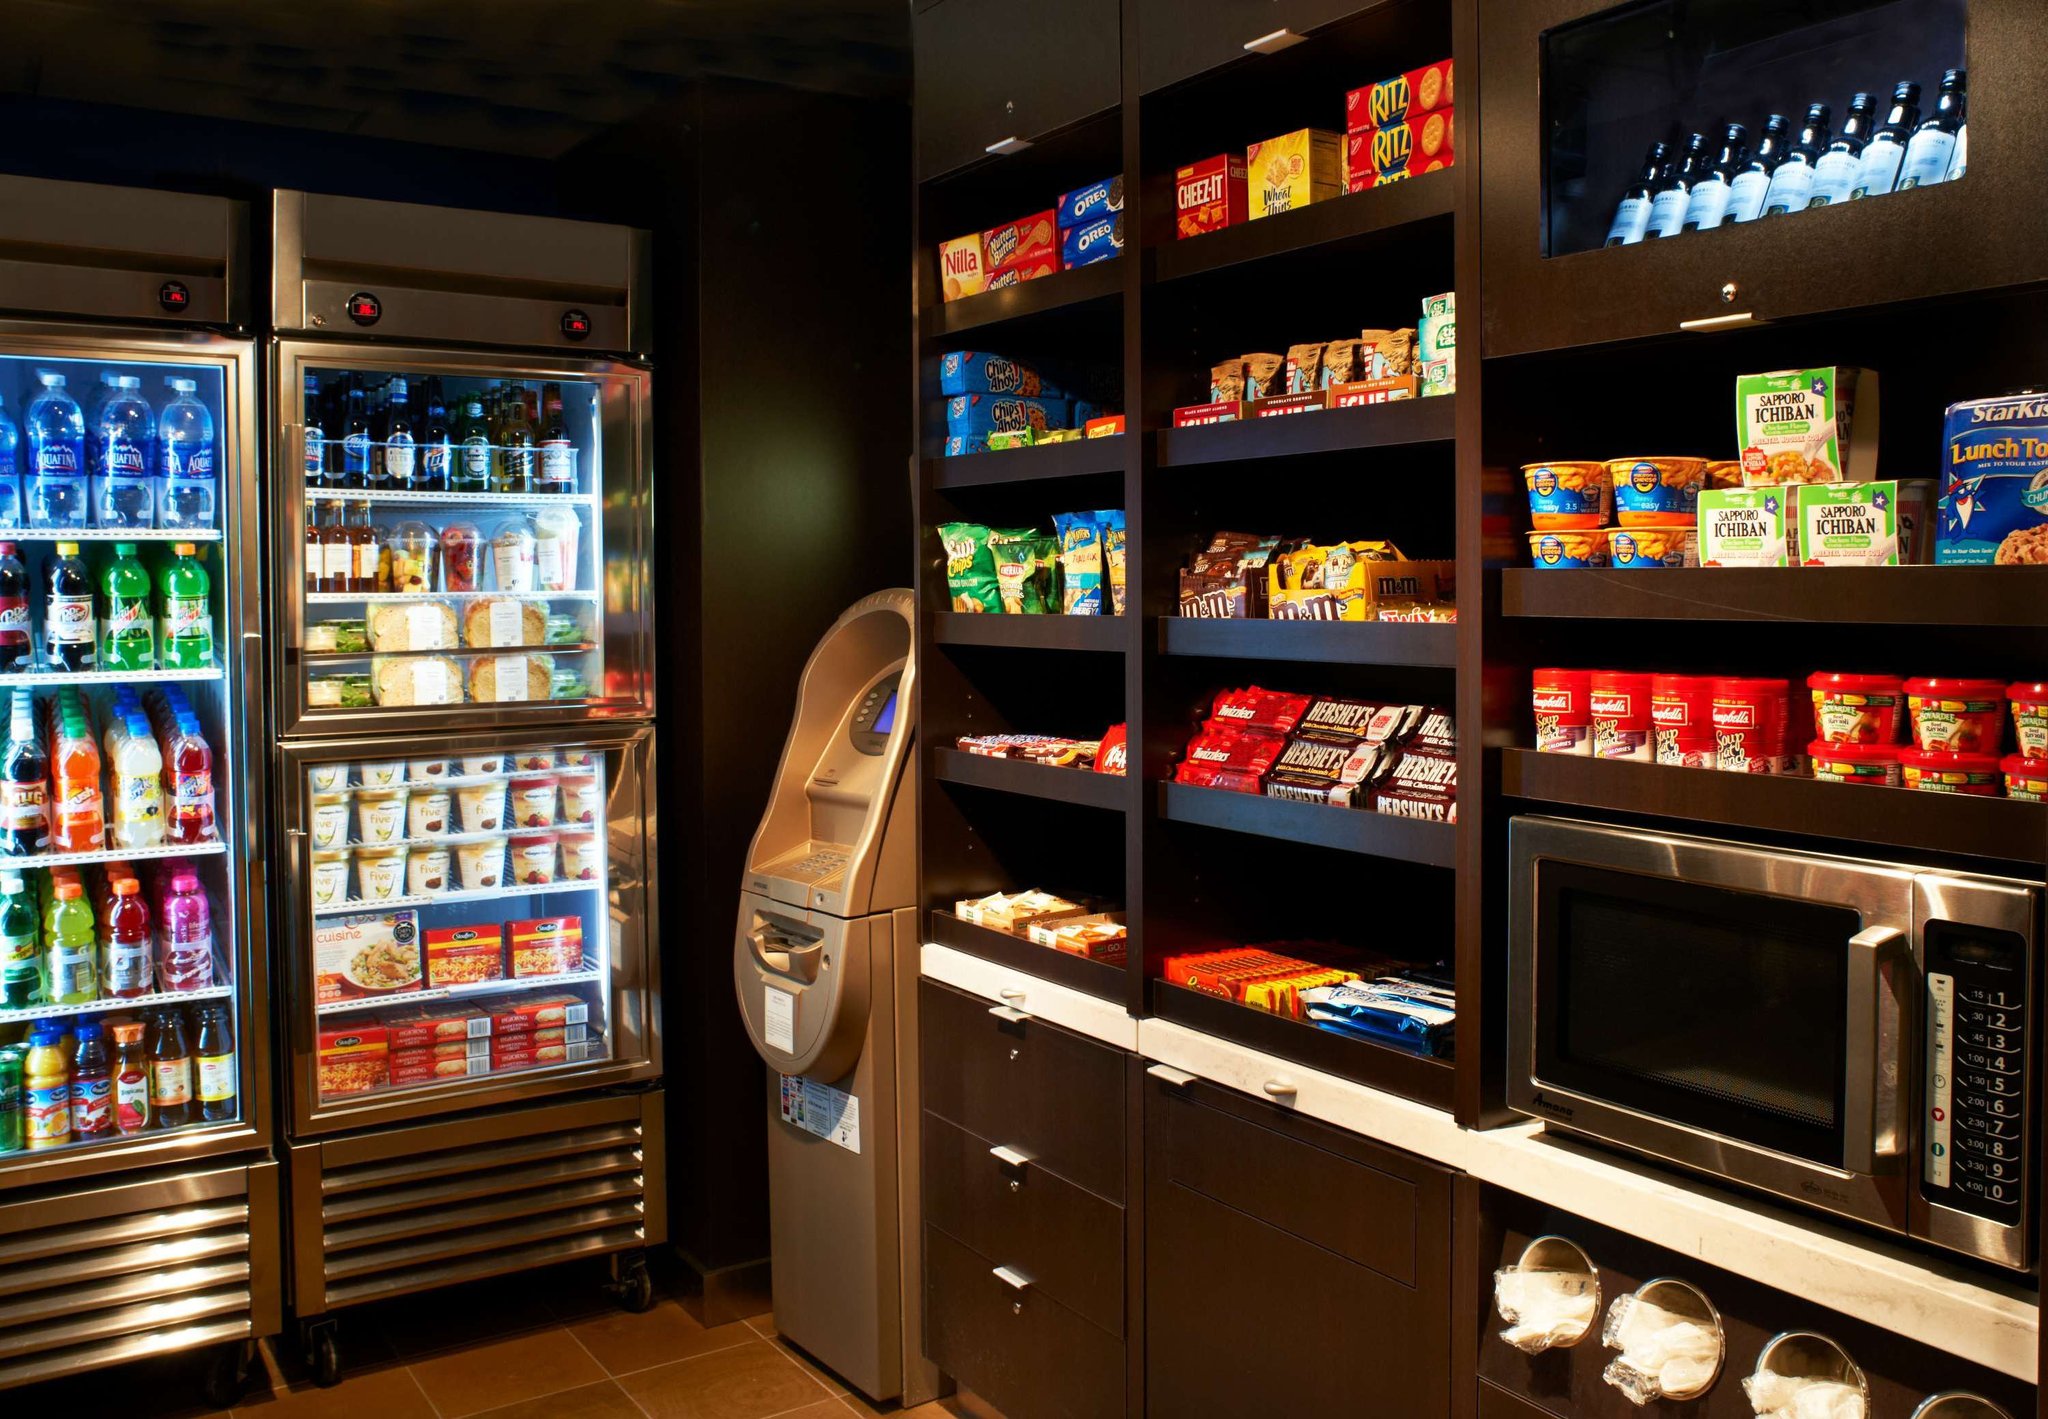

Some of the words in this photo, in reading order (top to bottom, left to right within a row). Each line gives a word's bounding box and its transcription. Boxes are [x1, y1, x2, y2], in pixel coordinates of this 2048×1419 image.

[1372, 77, 1407, 127] RITZ
[1374, 124, 1410, 172] RITZ
[1178, 175, 1223, 209] CHEEZ-IT
[1263, 186, 1292, 206] Wheat
[1074, 189, 1107, 217] OREO
[990, 227, 1014, 255] Nutter
[1078, 224, 1111, 251] OREO
[994, 237, 1016, 266] Butter
[946, 248, 977, 276] Nilla
[986, 359, 1013, 379] Chips
[991, 369, 1019, 392] Ahoy!
[1760, 392, 1805, 407] SAPPORO
[993, 401, 1020, 421] Chips
[1755, 404, 1814, 423] ICHIBAN
[1951, 437, 2018, 465] Lunch
[1542, 503, 1559, 513] easy
[1565, 502, 1578, 510] 3.5
[1641, 503, 1660, 511] easy
[1821, 505, 1866, 518] SAPPORO
[1718, 509, 1758, 522] SAPPORO
[1714, 522, 1767, 537] ICHIBAN
[1816, 518, 1876, 535] ICHIBAN
[948, 539, 975, 559] Sun
[949, 555, 973, 577] Chips
[1218, 704, 1255, 719] Twizzlers
[1306, 701, 1375, 727] HERSHEY'S
[1334, 725, 1354, 733] Almonds
[1536, 713, 1559, 730] Soup
[1594, 718, 1618, 735] Soup
[1422, 736, 1437, 744] Milk
[1655, 726, 1679, 743] Soup
[1716, 730, 1744, 750] Soup
[1548, 740, 1571, 750] CALORIES
[1606, 745, 1631, 754] CALORIES
[1192, 747, 1230, 762] Twizzlers
[1281, 740, 1350, 770] HERSHEY'S
[1397, 780, 1412, 788] Milk
[1413, 782, 1446, 791] Chocolate
[1378, 795, 1444, 822] HERSHEY'S
[317, 930, 362, 944] cuisine
[1971, 991, 1983, 999] :15
[1997, 992, 2005, 1005] 1
[1972, 1012, 1984, 1020] :30
[1996, 1013, 2006, 1027] 2
[1996, 1035, 2005, 1048] 3
[1968, 1053, 1985, 1063] 1:00
[1995, 1057, 2005, 1070] 4
[1969, 1075, 1985, 1085] 1:30
[1995, 1078, 2004, 1091] 5
[1533, 1093, 1574, 1117] Amana
[1968, 1096, 1985, 1107] 2:00
[1994, 1100, 2004, 1113] 6
[1968, 1117, 1985, 1128] 2:30
[1994, 1120, 2004, 1134] 7
[1967, 1139, 1985, 1149] 3:00
[1993, 1142, 2004, 1156] 8
[1967, 1160, 1985, 1171] 3:30
[1993, 1164, 2003, 1177] 9
[1966, 1181, 1983, 1192] 4:00
[1992, 1185, 2003, 1199] 0
